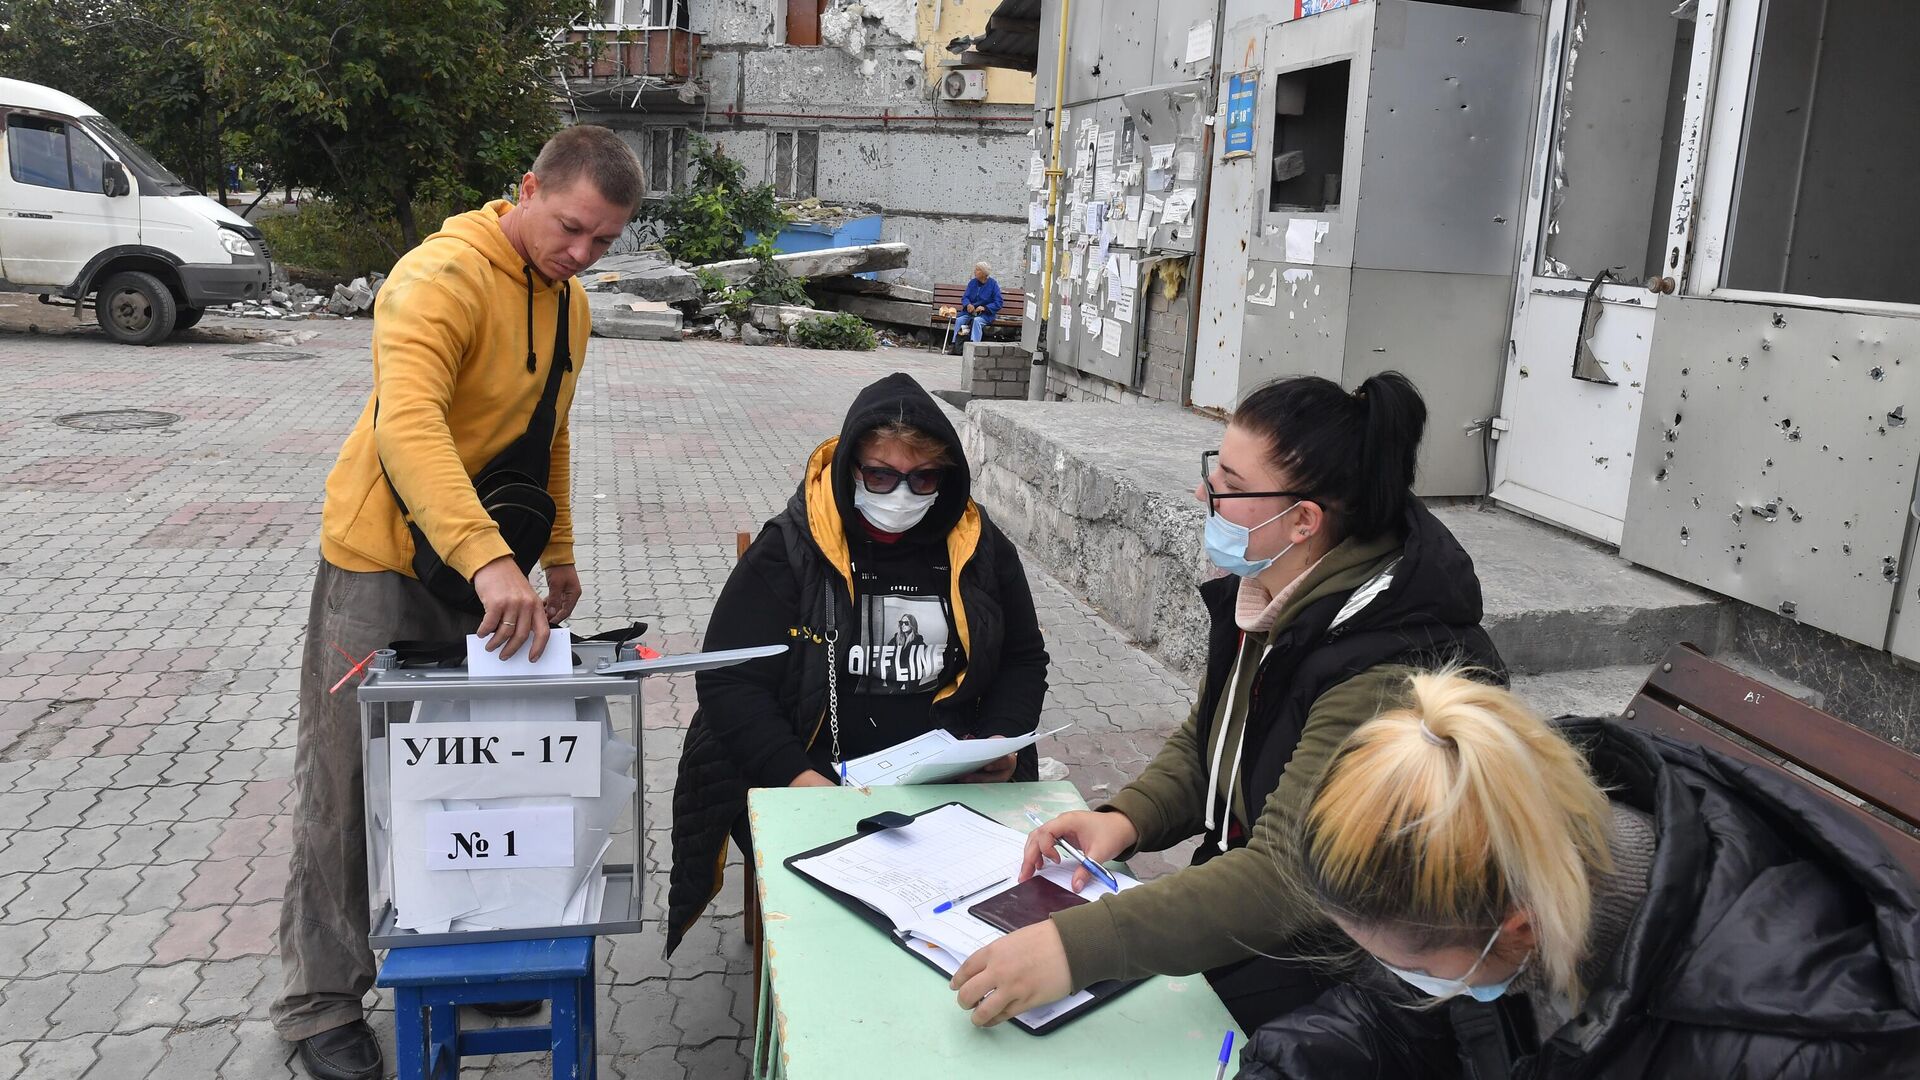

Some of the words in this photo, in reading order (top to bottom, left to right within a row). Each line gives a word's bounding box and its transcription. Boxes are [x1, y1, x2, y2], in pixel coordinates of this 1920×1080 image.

[848, 644, 948, 682] OFFLINE
[401, 736, 500, 766] УИК
[539, 735, 578, 764] 17
[447, 831, 489, 860] №
[503, 830, 519, 857] 1
